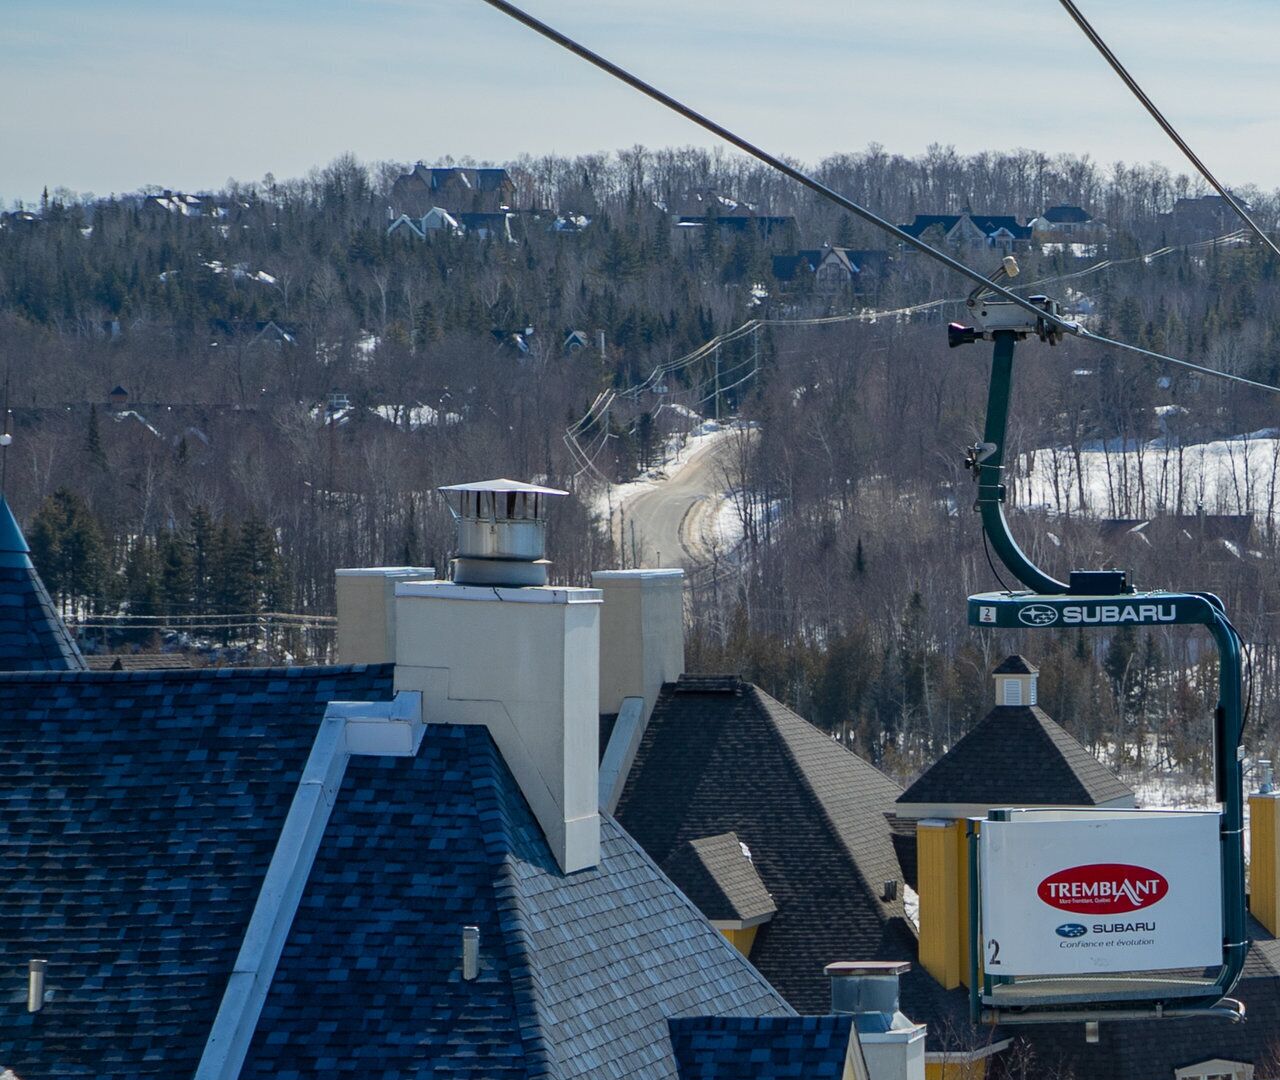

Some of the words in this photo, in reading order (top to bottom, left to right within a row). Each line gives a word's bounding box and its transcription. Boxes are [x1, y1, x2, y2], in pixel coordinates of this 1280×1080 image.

[1062, 604, 1176, 623] SUBARU
[1047, 878, 1160, 906] TREMBLANT
[1092, 922, 1156, 934] SUBARU
[987, 938, 1001, 965] 2
[1059, 940, 1104, 949] Confiance
[1116, 938, 1155, 947] évolution
